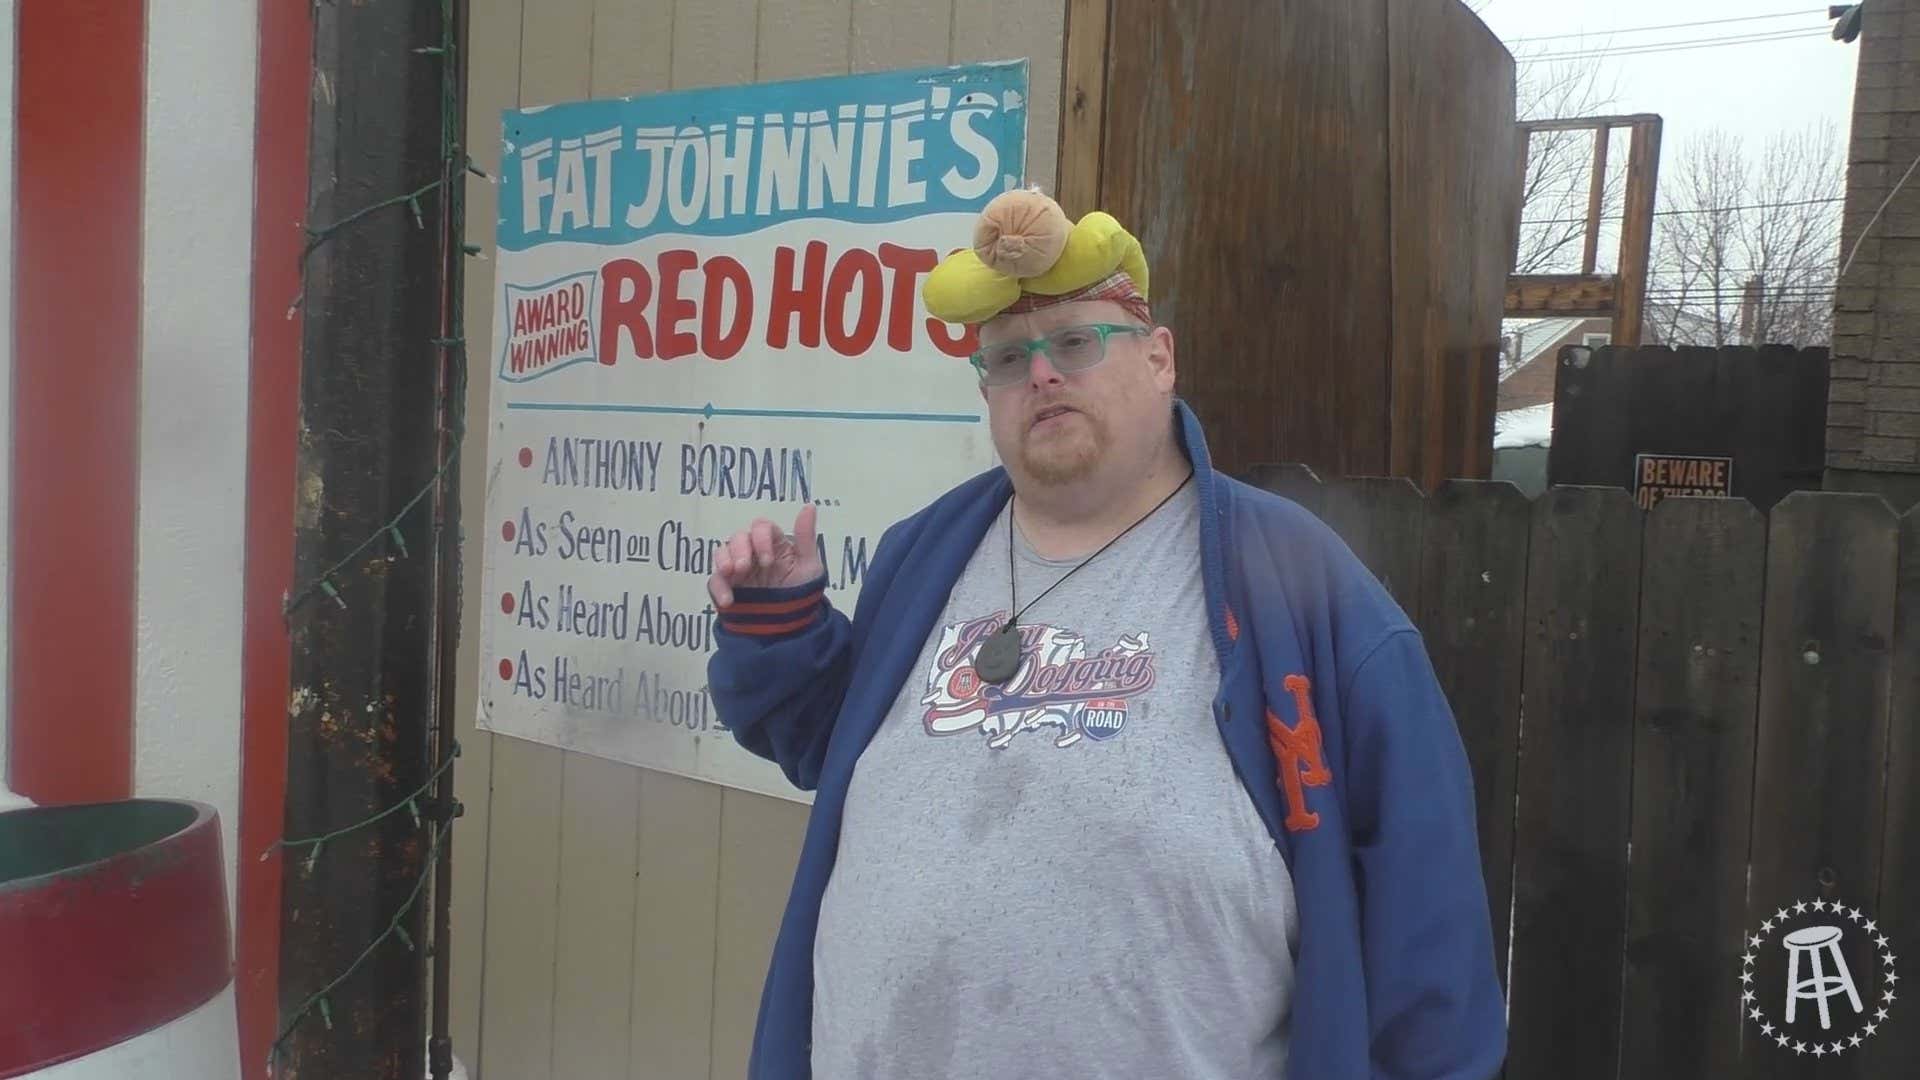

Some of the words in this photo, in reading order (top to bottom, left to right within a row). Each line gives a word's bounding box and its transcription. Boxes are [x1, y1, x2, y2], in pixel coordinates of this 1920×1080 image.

[521, 126, 622, 234] FAT
[625, 86, 1000, 229] JOHNNIE'S
[513, 282, 585, 338] AWARD
[600, 249, 754, 365] RED
[510, 319, 590, 374] WINNING
[542, 436, 662, 492] ANTHONY
[1642, 458, 1726, 487] BEWARE
[1637, 485, 1658, 512] OF
[515, 507, 548, 557] As
[557, 510, 621, 564] Seen
[626, 535, 650, 562] on
[517, 580, 550, 633] As
[557, 584, 628, 641] Heard
[636, 594, 714, 653] About
[513, 649, 547, 699] As
[554, 656, 625, 716] Heard
[634, 669, 712, 731] About
[1086, 709, 1123, 729] ROAD
